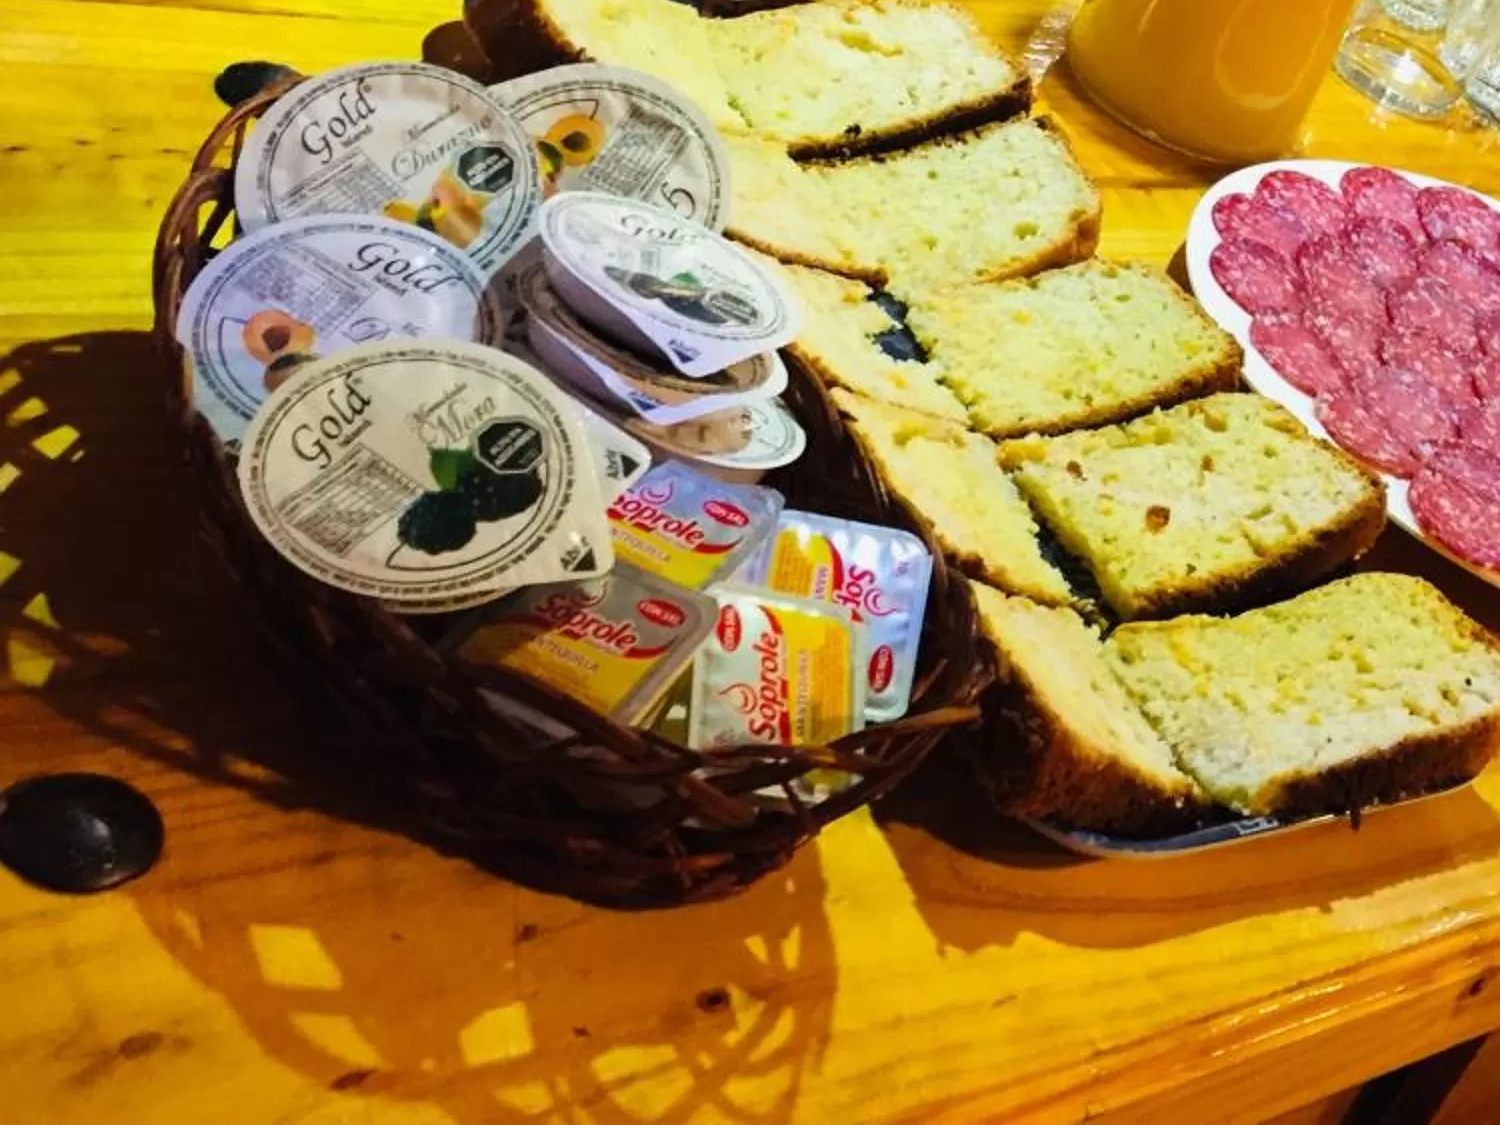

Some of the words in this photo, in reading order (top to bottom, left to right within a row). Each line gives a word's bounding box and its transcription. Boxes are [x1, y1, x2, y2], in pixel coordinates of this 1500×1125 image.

[301, 76, 376, 165] Gold
[349, 242, 465, 293] Gold
[291, 370, 372, 470] Gold
[414, 394, 497, 449] Mora
[535, 592, 638, 648] Soprole
[748, 631, 780, 741] Soprole
